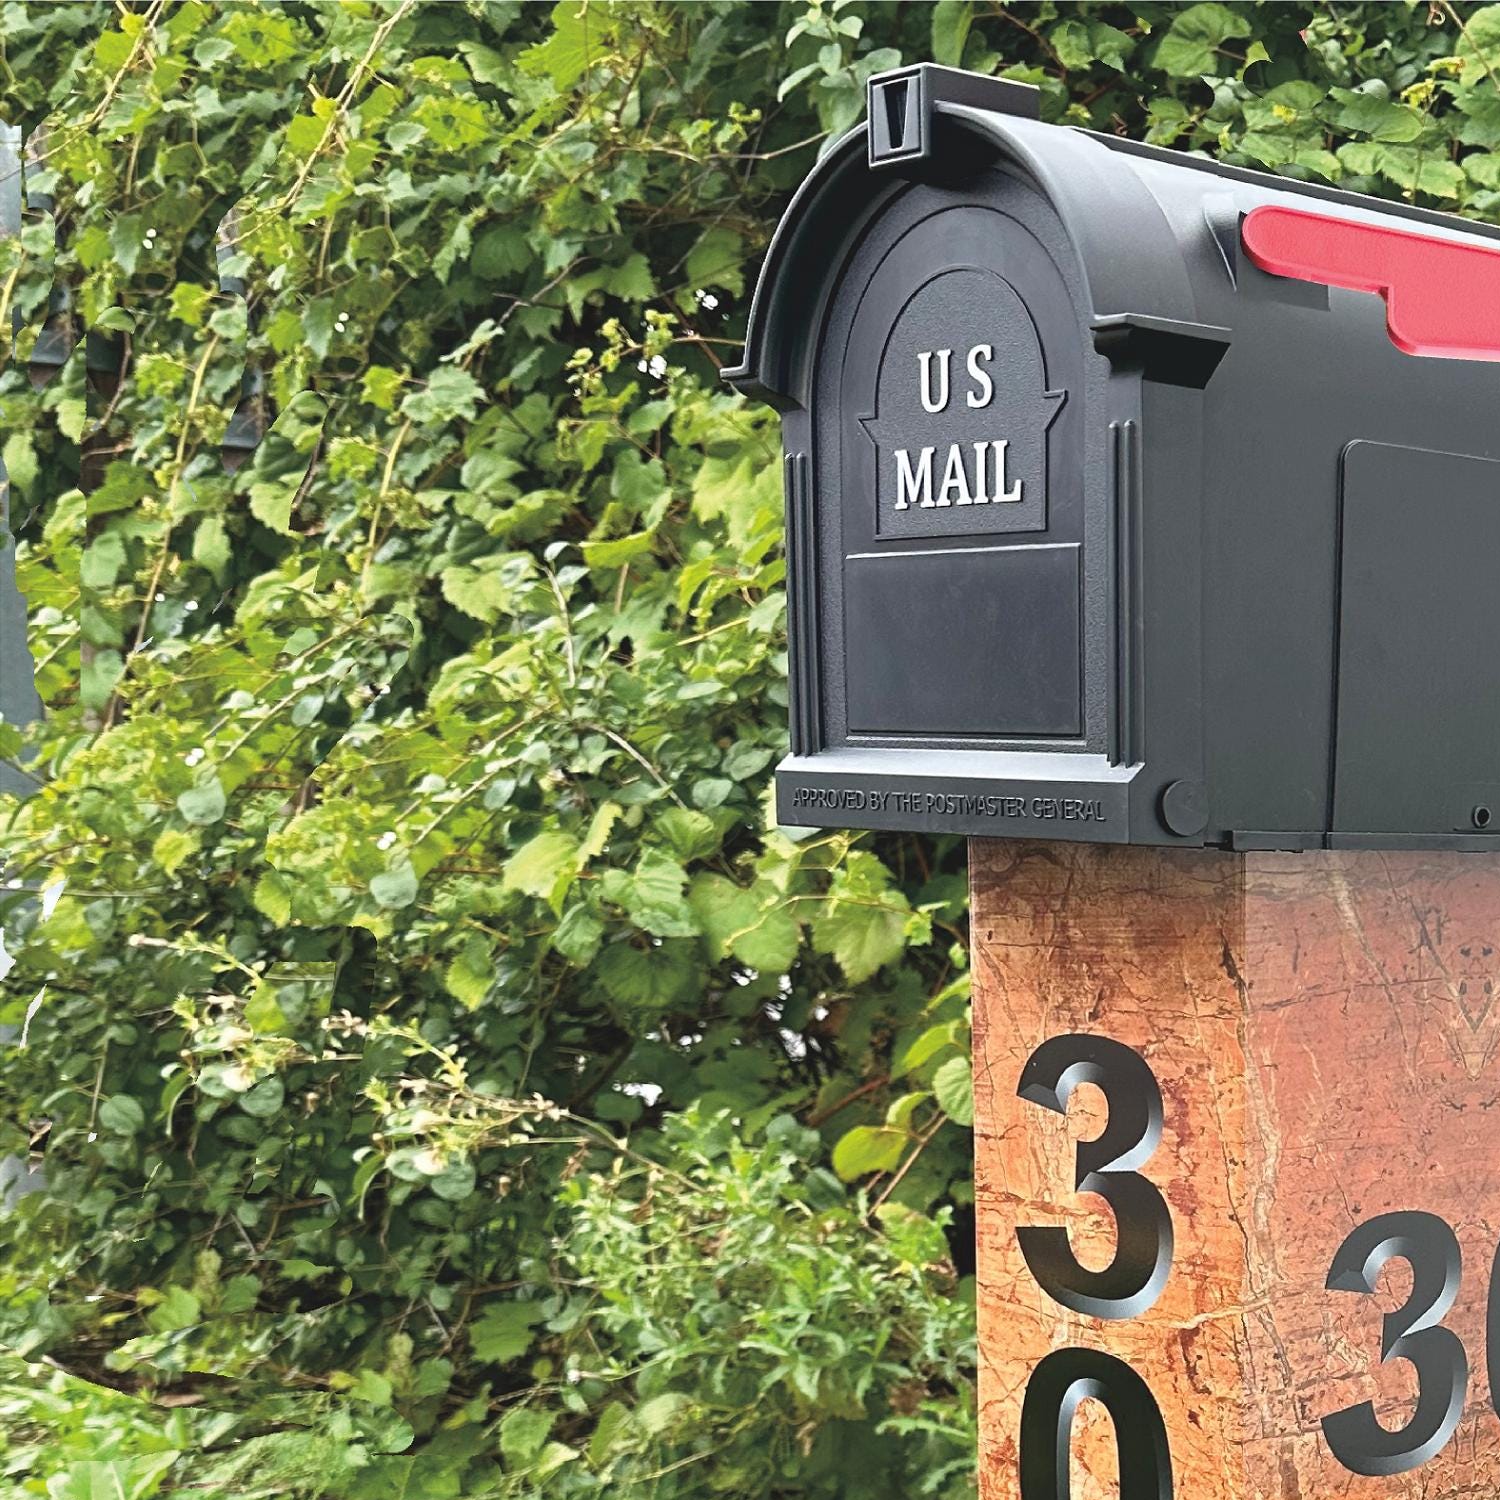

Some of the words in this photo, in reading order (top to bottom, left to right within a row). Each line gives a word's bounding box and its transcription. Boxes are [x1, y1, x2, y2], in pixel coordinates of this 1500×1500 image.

[894, 440, 1022, 510] MAIL
[793, 787, 867, 811] APPROVED
[869, 791, 890, 812] BY
[892, 793, 923, 814] THE
[926, 794, 1029, 819] POSTMASTER
[1032, 797, 1105, 823] GENERAL
